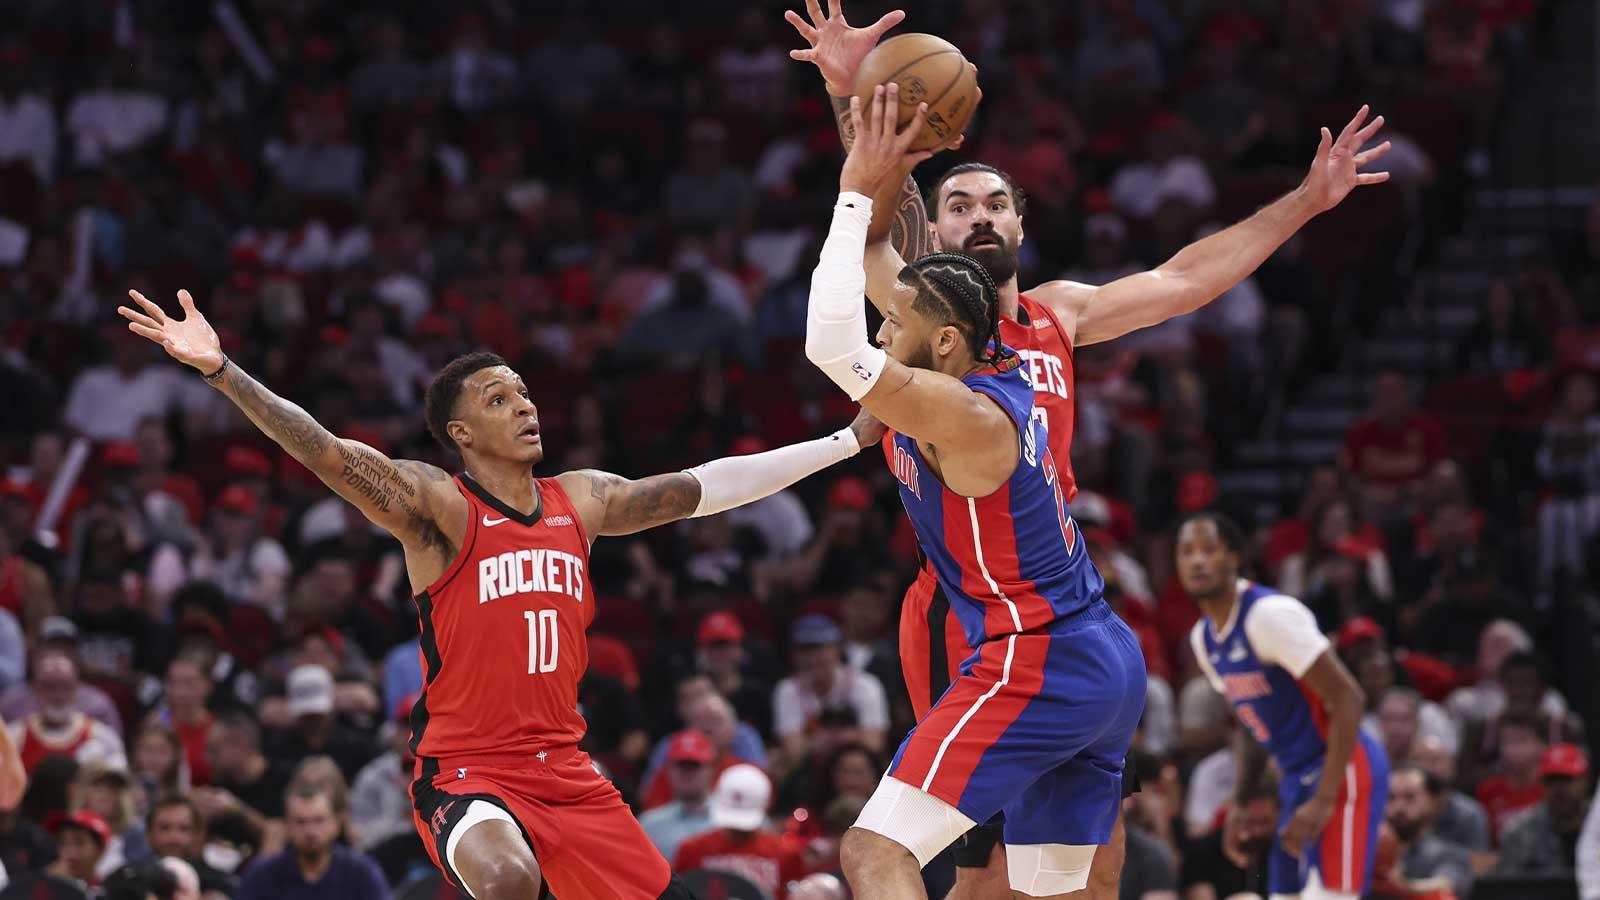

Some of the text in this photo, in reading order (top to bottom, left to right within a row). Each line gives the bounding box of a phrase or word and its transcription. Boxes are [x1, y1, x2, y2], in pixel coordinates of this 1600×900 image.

[341, 465, 391, 513] POTENTIAL
[1041, 446, 1076, 557] 2
[479, 549, 584, 604] ROCKETS
[524, 608, 559, 675] 10
